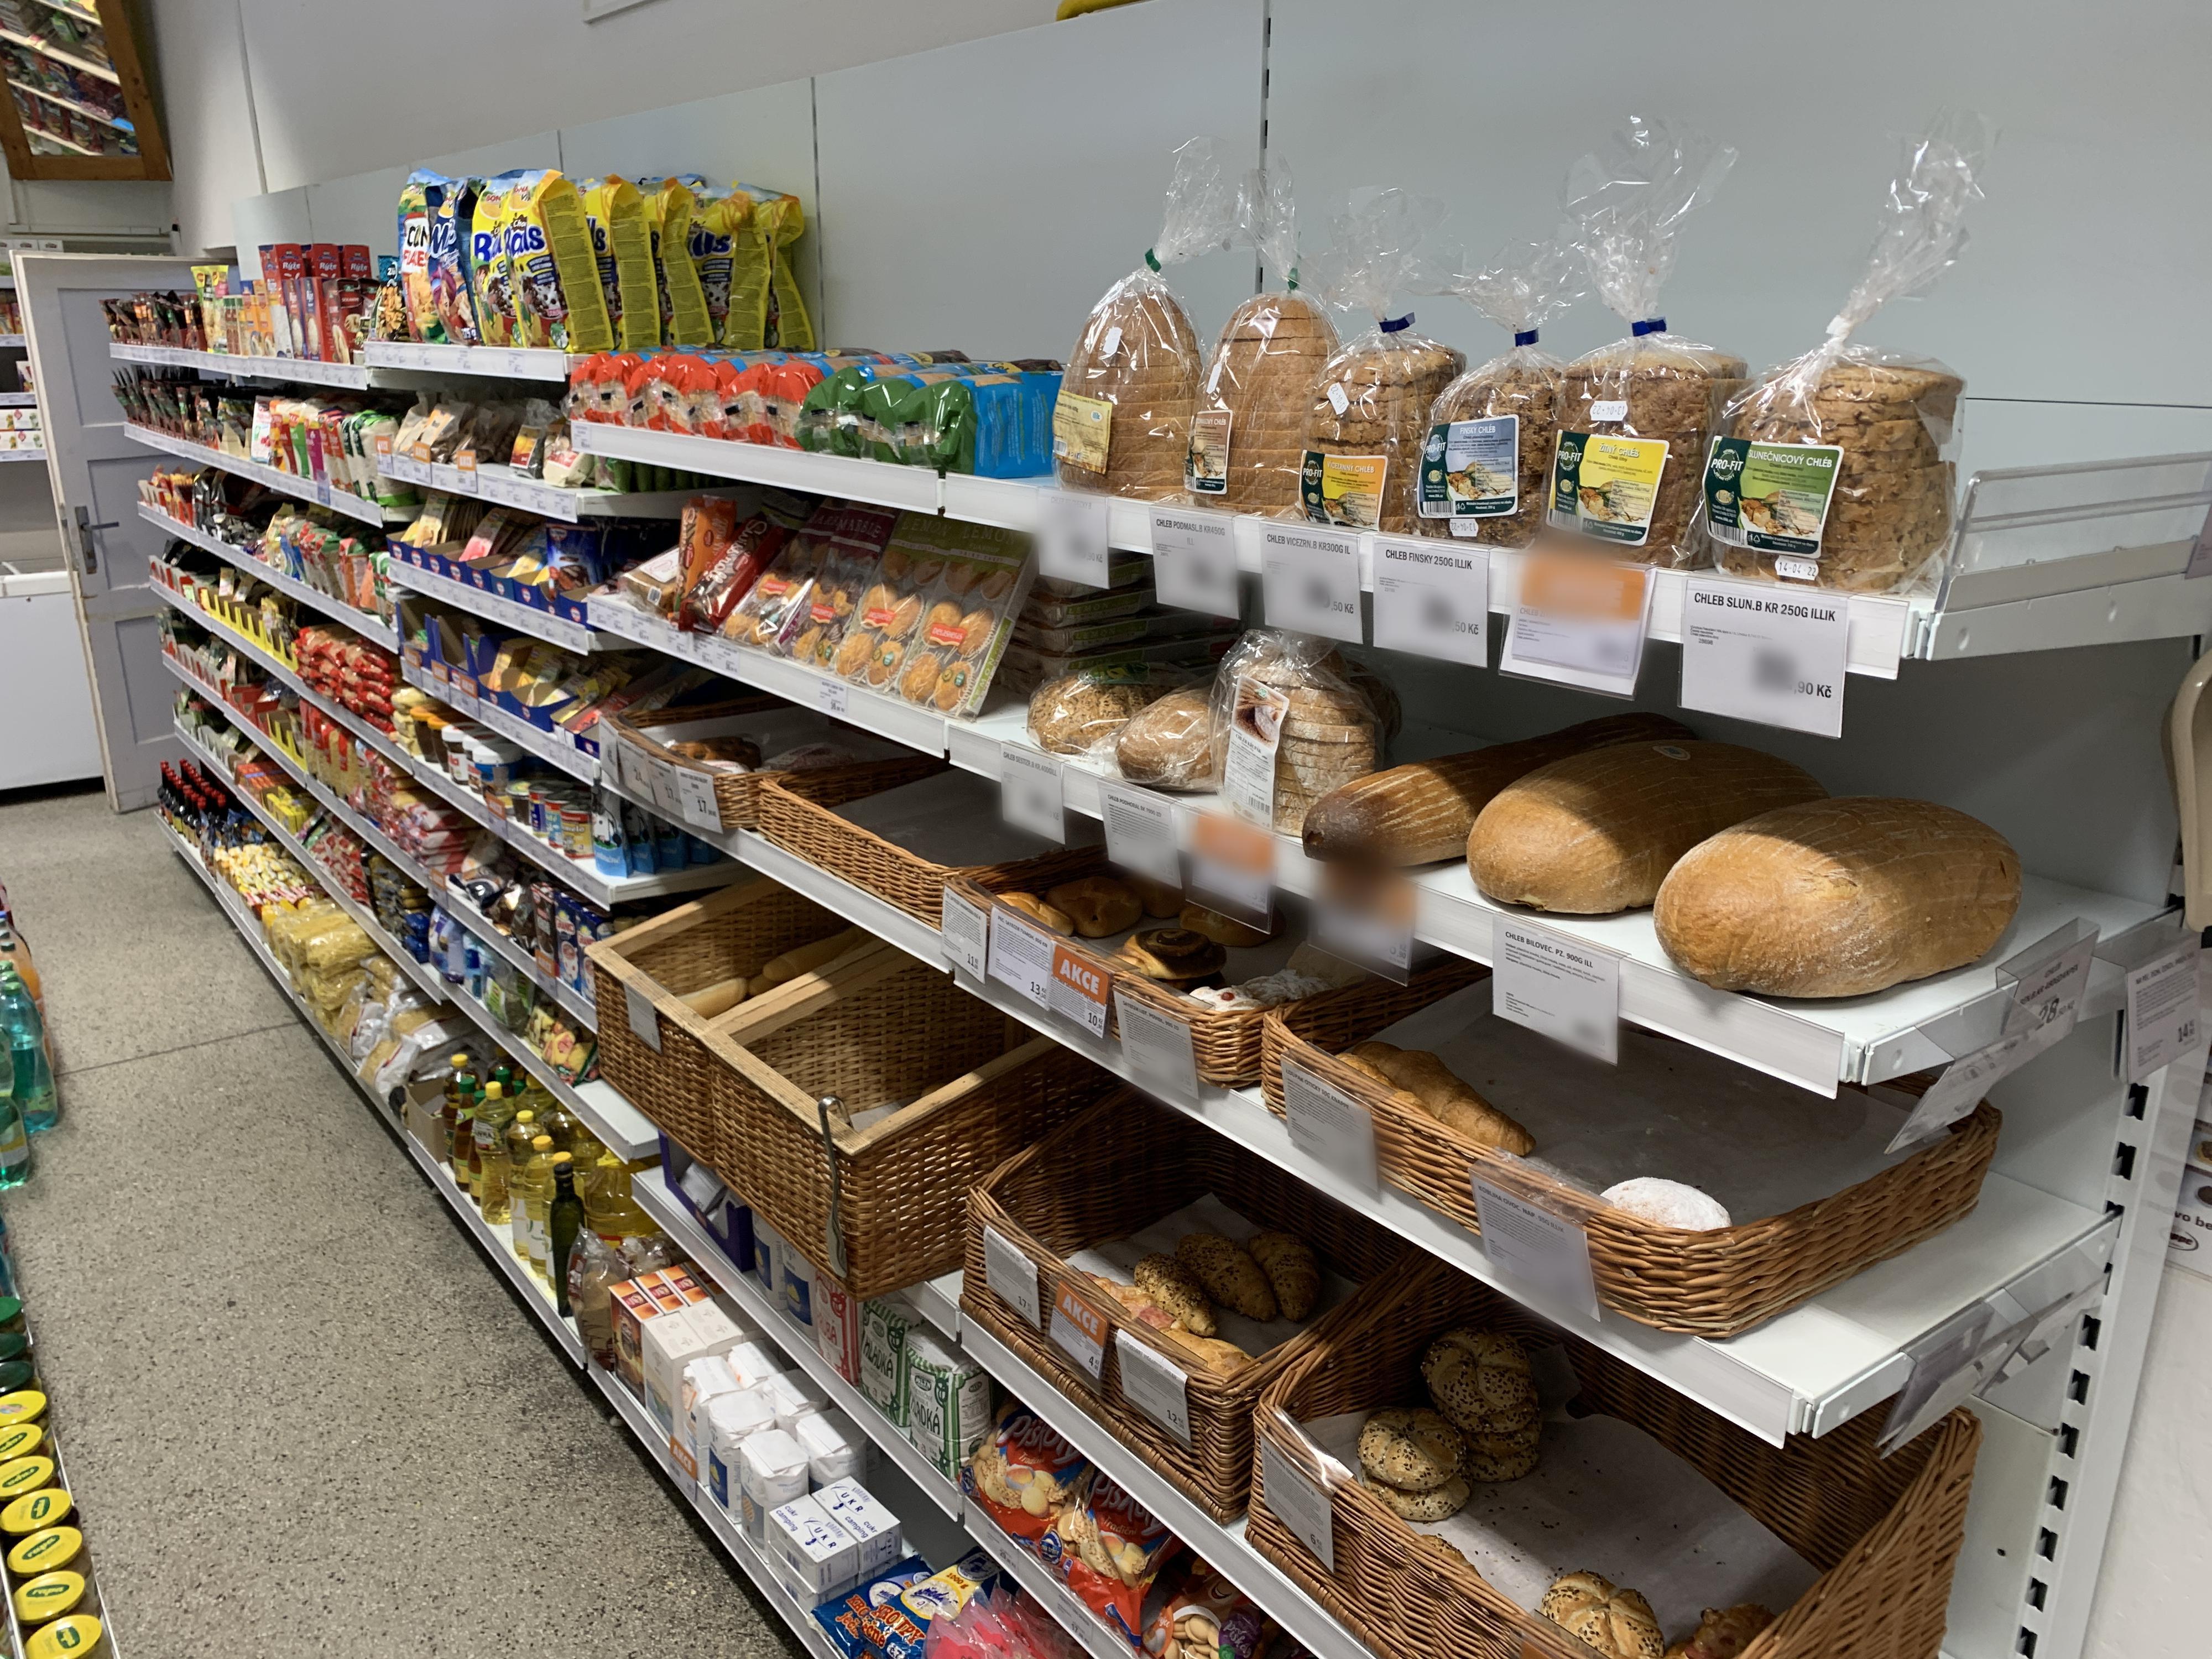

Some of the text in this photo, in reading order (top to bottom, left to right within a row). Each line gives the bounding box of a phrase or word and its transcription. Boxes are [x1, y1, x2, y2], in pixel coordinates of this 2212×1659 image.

[283, 262, 301, 270] Rýže
[320, 262, 337, 270] Rýže
[1460, 424, 1495, 434] FINSKÝ CHLÉB
[1558, 450, 1582, 462] PRO-FIT
[1599, 443, 1640, 458] ŽITNÝ CHLÉB
[1711, 458, 1744, 471] PRO-FIT
[1748, 449, 1833, 468] SLUNEČNICOVÝ CHLÉB
[1303, 468, 1322, 478] PRO-FIT
[1355, 464, 1374, 473] CHLÉB
[902, 518, 952, 538] LEMON
[1156, 519, 1172, 528] CHLEB
[963, 525, 1017, 545] LEMON
[1267, 534, 1285, 545] CHLEB
[1286, 536, 1317, 549] VICEZRN.B
[1318, 541, 1344, 554] KR300G
[1386, 549, 1472, 570] CHLEB FINSKY 250G ILLIK
[1344, 603, 1354, 614] Kč
[1694, 592, 1836, 622] CHLEB SLUN.B KR 250G ILLIK
[1468, 623, 1479, 635] Kč
[1817, 684, 1832, 698] Kč
[1108, 794, 1119, 802] CHLEB
[698, 799, 707, 813] 17
[1505, 931, 1525, 943] CHLEB
[1526, 938, 1554, 954] BILOVEC.
[1566, 953, 1583, 964] 900G
[1584, 959, 1593, 968] ILL
[968, 953, 974, 967] 11
[1060, 959, 1100, 994] AKCE
[1030, 981, 1040, 995] 13
[1088, 1012, 1097, 1026] 10
[1019, 1296, 1026, 1307] 17
[1063, 1294, 1099, 1336] AKCE
[1089, 1357, 1094, 1366] 4
[1167, 1410, 1178, 1424] 12
[785, 1505, 798, 1517] cukr
[776, 1509, 799, 1532] camping
[844, 1516, 869, 1538] camping
[864, 1521, 878, 1533] cukr
[1103, 1516, 1138, 1536] Tradiční
[1311, 1535, 1316, 1545] 6
[946, 1573, 963, 1585] 1000
[870, 1604, 926, 1646] KROUPY
